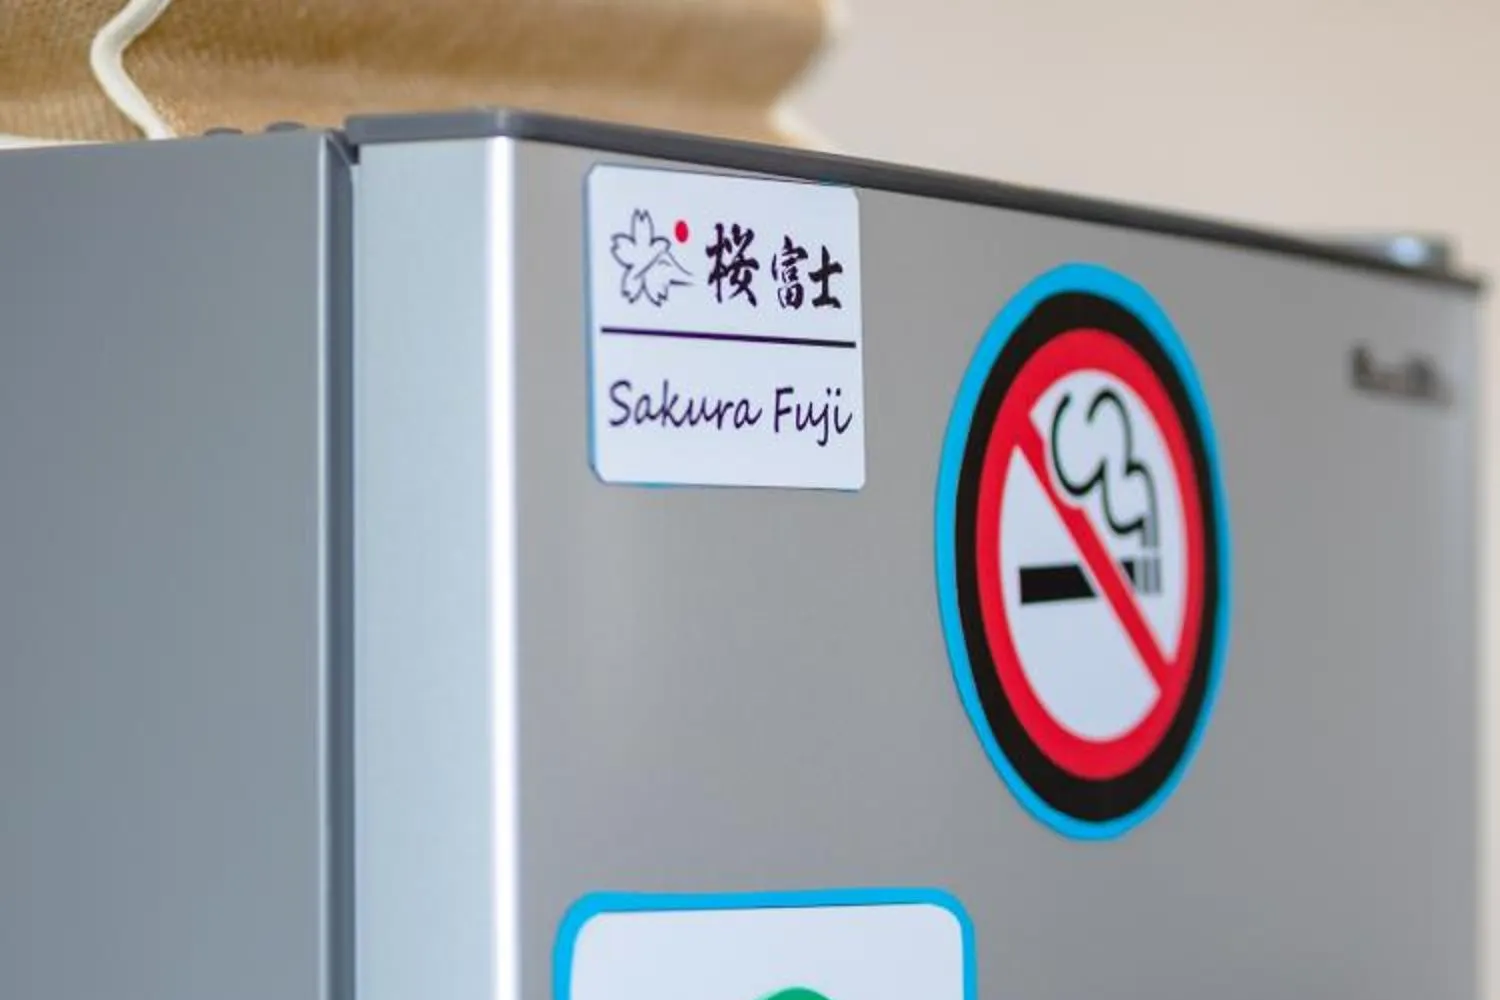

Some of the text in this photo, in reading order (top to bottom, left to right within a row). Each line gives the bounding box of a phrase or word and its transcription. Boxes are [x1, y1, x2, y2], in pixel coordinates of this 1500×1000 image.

[705, 222, 844, 309] 桜富士
[608, 378, 853, 447] Sakura Fuji
